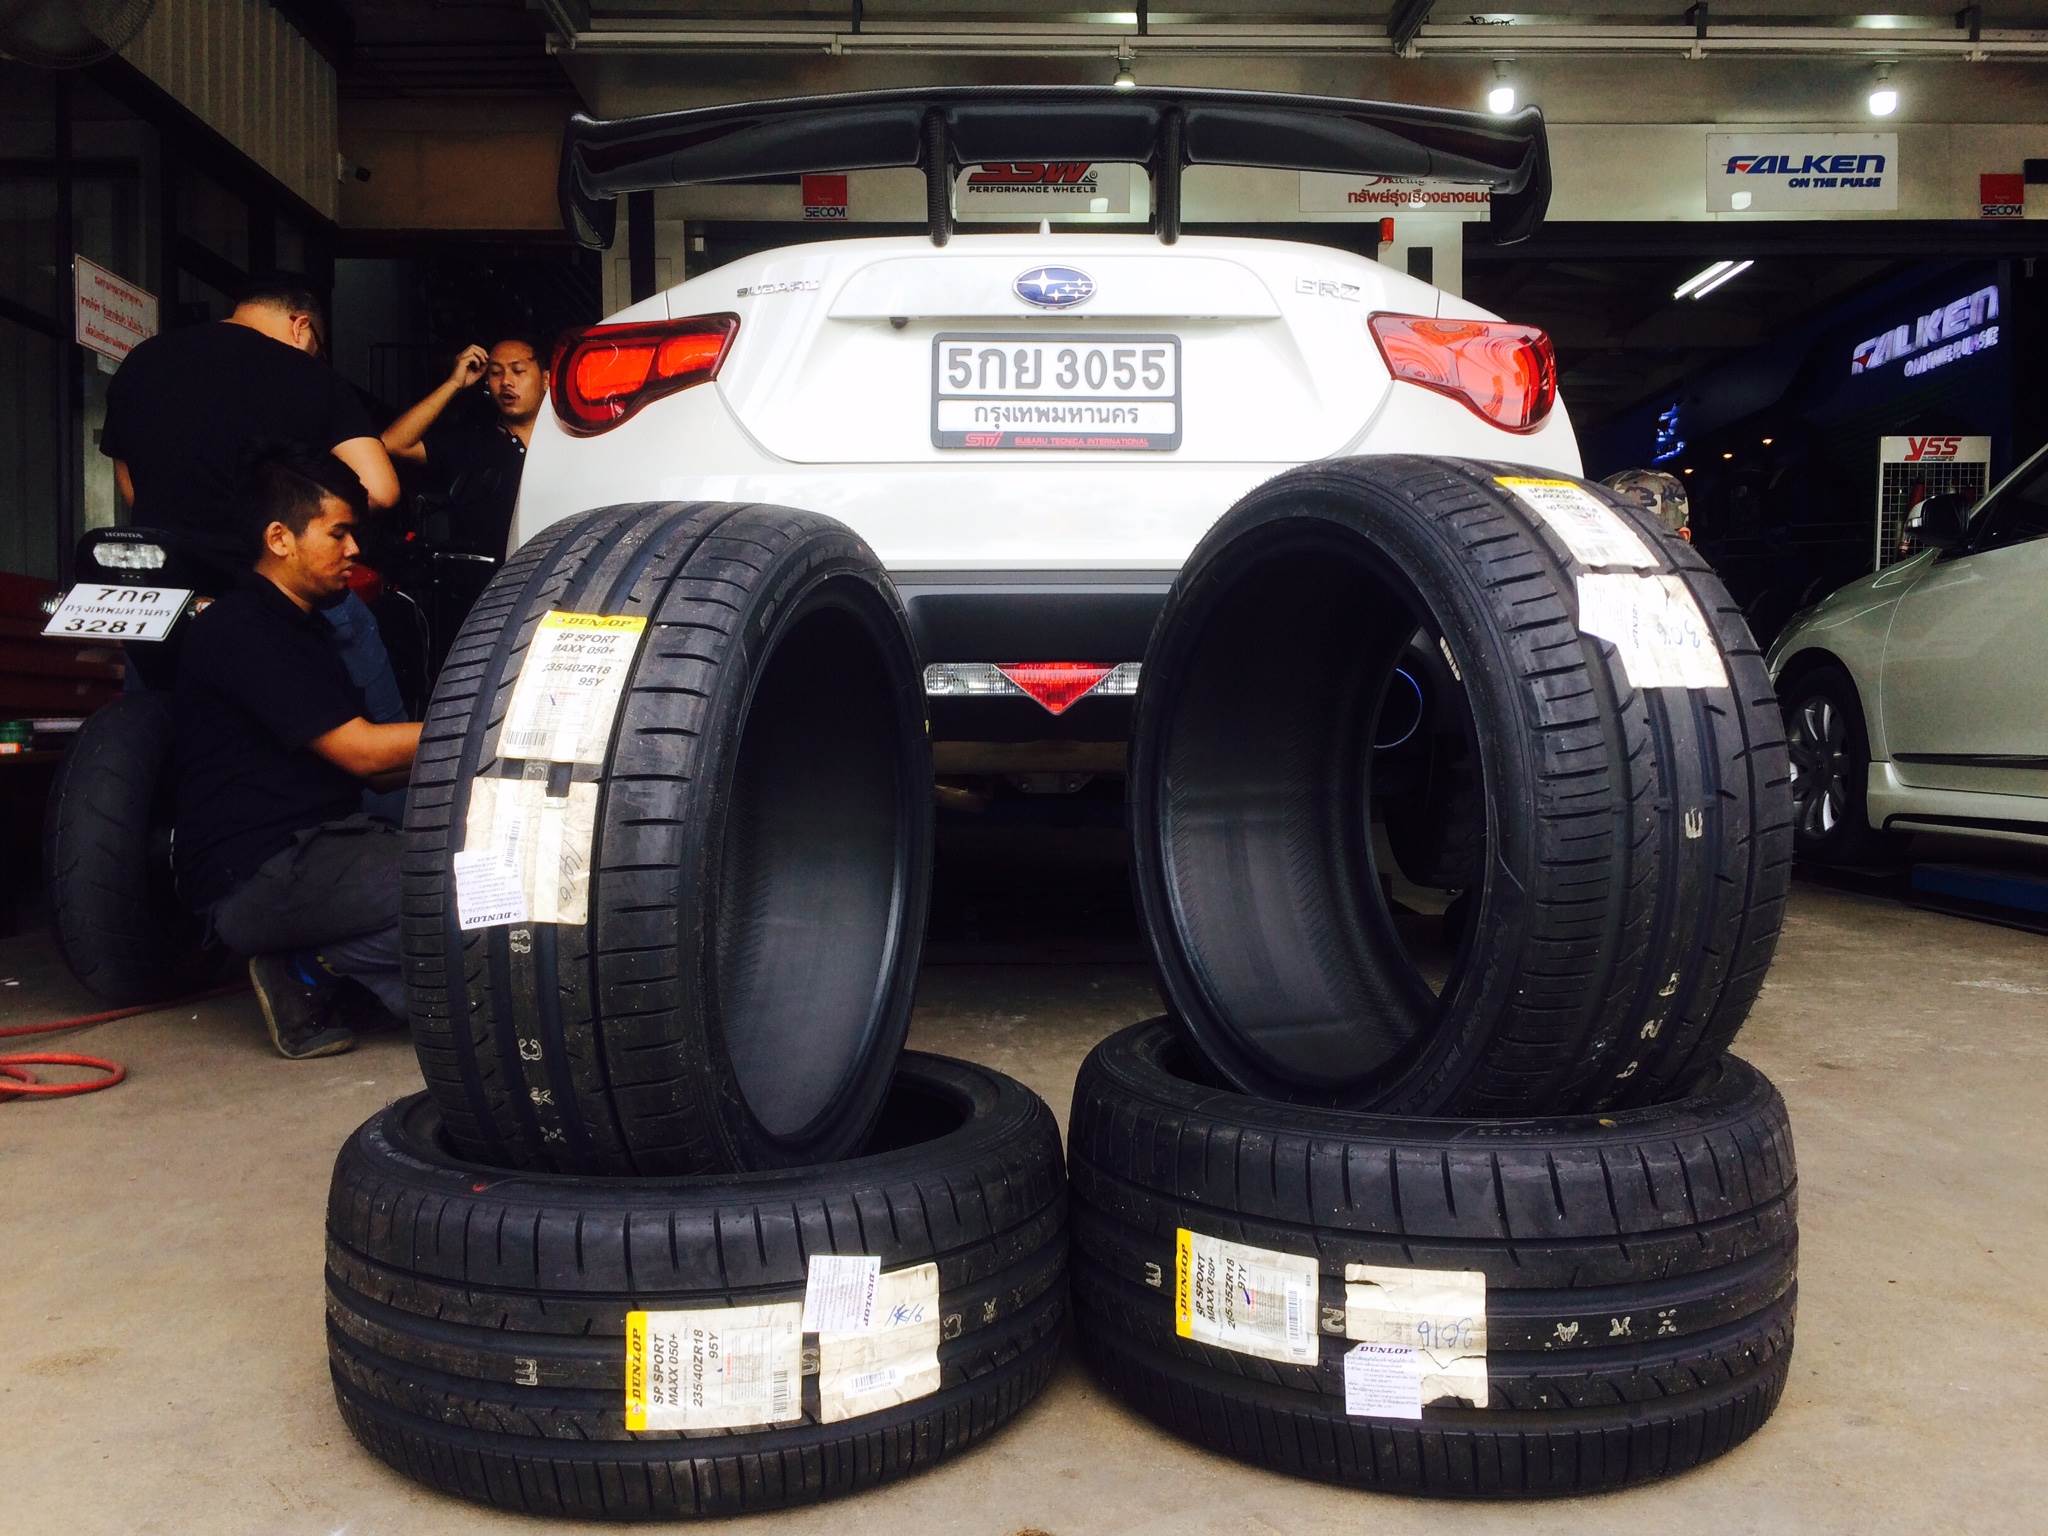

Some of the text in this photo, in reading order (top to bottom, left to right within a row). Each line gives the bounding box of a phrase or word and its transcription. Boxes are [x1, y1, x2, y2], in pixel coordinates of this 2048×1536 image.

[1725, 154, 1886, 174] FALKEN
[968, 186, 1097, 194] PERFORMANCE WHEELS
[1788, 177, 1882, 188] ON THE PULSE
[804, 206, 846, 218] SECOM
[1982, 204, 2022, 216] SECOM
[1851, 285, 1999, 376] FALKEN
[948, 347, 1166, 391] 5กย 3055
[974, 405, 1140, 430] กรุงเทพมหานคร
[1903, 436, 1963, 462] YSS
[64, 604, 174, 617] กรุงเทพมหานคร
[568, 617, 633, 627] DUNLOP
[64, 618, 148, 635] 3281
[556, 632, 621, 644] SP SPORT
[577, 676, 605, 687] 95Y
[464, 911, 512, 925] DUNLOP
[1180, 1243, 1189, 1312] DUNLOP
[1195, 1252, 1206, 1318] SP SPORT
[1237, 1263, 1247, 1290] 97Y
[863, 1271, 877, 1327] DUNLOP
[1206, 1256, 1217, 1324] MAXX 050+
[708, 1332, 719, 1360] 95Y
[1359, 1345, 1413, 1355] DUNLOP
[632, 1327, 642, 1401] DUNLOP
[653, 1333, 665, 1405] SP SPORT
[668, 1332, 679, 1406] MAXX 050+
[693, 1328, 704, 1409] 235/40ZR18
